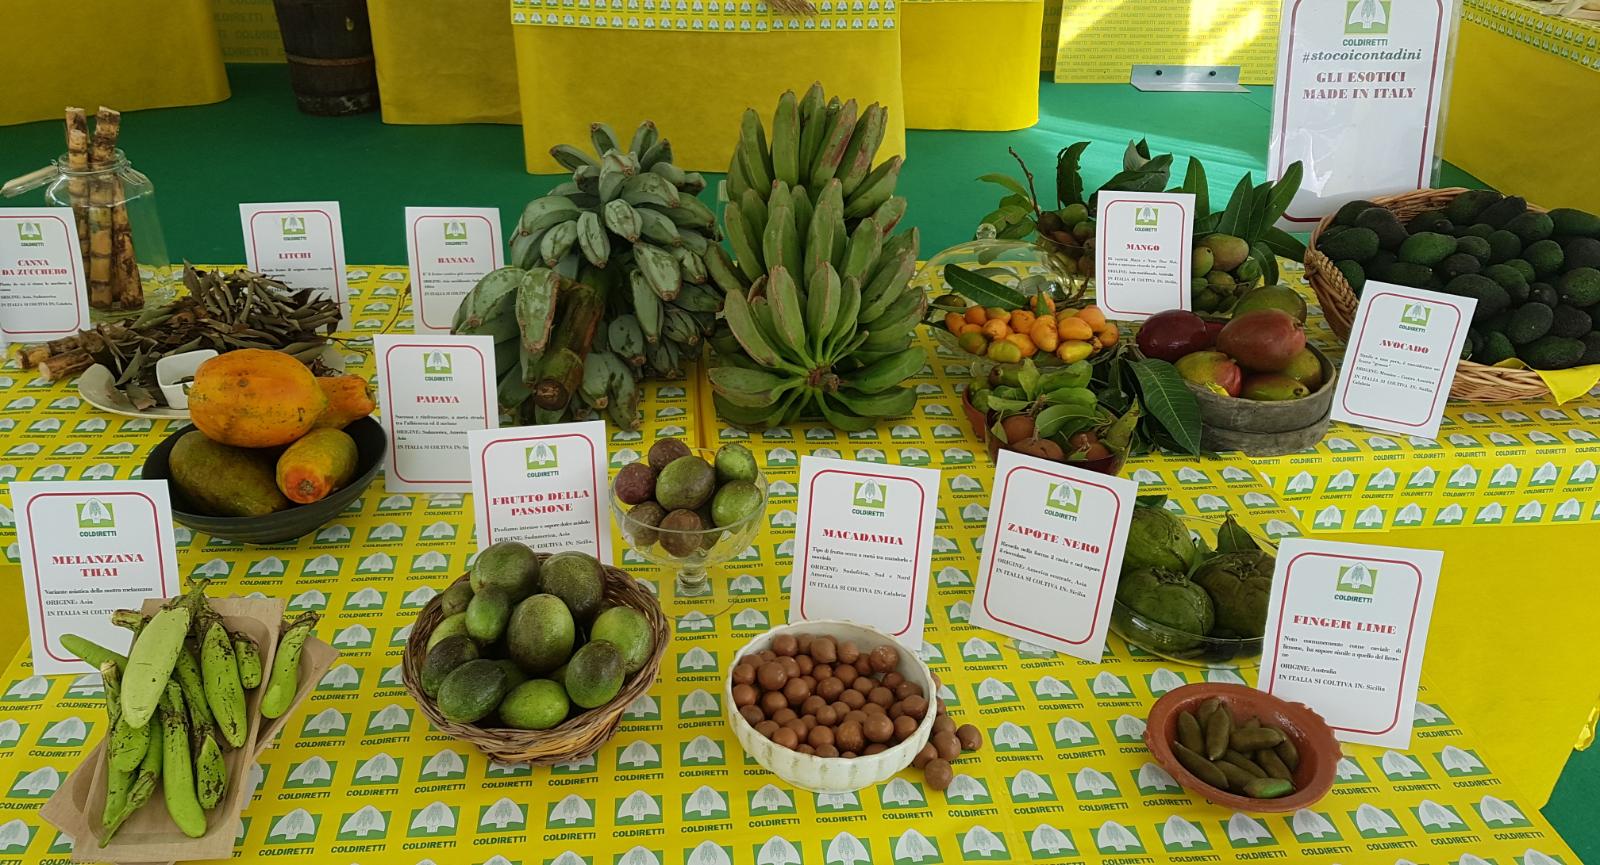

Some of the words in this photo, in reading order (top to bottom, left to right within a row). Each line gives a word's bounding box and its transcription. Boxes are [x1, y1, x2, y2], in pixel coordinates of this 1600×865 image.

[1302, 48, 1422, 64] #stocoicontadini
[1316, 72, 1342, 83] GLI
[1348, 71, 1406, 83] ESOTICI
[1302, 89, 1348, 100] MADE
[1352, 89, 1370, 99] IN
[1374, 88, 1416, 99] ITALY
[1379, 340, 1429, 354] AVOCADO
[1374, 453, 1405, 461] COLDIRETTI
[1413, 452, 1445, 460] COLDIRETTI
[1496, 449, 1526, 457] COLDIRETTI
[493, 494, 543, 505] FRUTTO
[548, 490, 590, 501] DELLA
[511, 503, 573, 516] PASSIONE
[852, 509, 885, 517] COLDIRETTI
[1044, 509, 1077, 522] COLDIRETTI
[822, 529, 903, 545] MACADAMIA
[1008, 522, 1059, 543] ZAPOTE
[1062, 537, 1100, 554] NERO
[52, 553, 144, 565] MELANZANA
[80, 568, 118, 577] THAI
[811, 564, 838, 572] ORIGINE:
[1026, 566, 1049, 576] America
[817, 582, 838, 590] ITALIA
[847, 585, 872, 594] COLTIVA
[1004, 570, 1024, 580] ITALIA
[1032, 578, 1058, 590] COLTIVA
[1070, 588, 1086, 597] Sicilia
[1334, 594, 1373, 604] COLDIRETTI
[1293, 615, 1352, 630] FINGER
[1357, 622, 1397, 635] LIME
[1303, 639, 1343, 647] comunemente
[1280, 663, 1310, 672] ORIGINE:
[1311, 667, 1337, 675] Australia
[1289, 675, 1312, 683] ITALIA
[1323, 679, 1352, 688] COLTIVA
[1367, 684, 1385, 692] Sicilia
[979, 705, 1025, 715] COLDIRETTI
[678, 721, 725, 729] COLDIRETTI
[1417, 729, 1462, 738] COLDIRETTI
[361, 736, 410, 746] COLDIRETTI
[1057, 750, 1105, 760] COLDIRETTI
[548, 777, 599, 787] COLDIRETTI
[614, 773, 664, 782] COLDIRETTI
[1393, 784, 1441, 792] COLDIRETTI
[1453, 778, 1501, 789] COLDIRETTI
[347, 789, 399, 797] COLDIRETTI
[414, 784, 466, 794] COLDIRETTI
[1332, 786, 1381, 796] COLDIRETTI
[1078, 802, 1129, 812] COLDIRETTI
[948, 809, 998, 818] COLDIRETTI
[749, 818, 800, 828] COLDIRETTI
[816, 815, 867, 823] COLDIRETTI
[681, 823, 733, 833] COLDIRETTI
[544, 832, 596, 842] COLDIRETTI
[612, 829, 665, 838] COLDIRETTI
[1494, 831, 1545, 840] COLDIRETTI
[402, 840, 457, 850] COLDIRETTI
[473, 835, 527, 846] COLDIRETTI
[1366, 840, 1417, 851] COLDIRETTI
[1430, 836, 1482, 846] COLDIRETTI
[259, 847, 314, 857] COLDIRETTI
[331, 844, 386, 854] COLDIRETTI
[1301, 846, 1352, 857] COLDIRETTI
